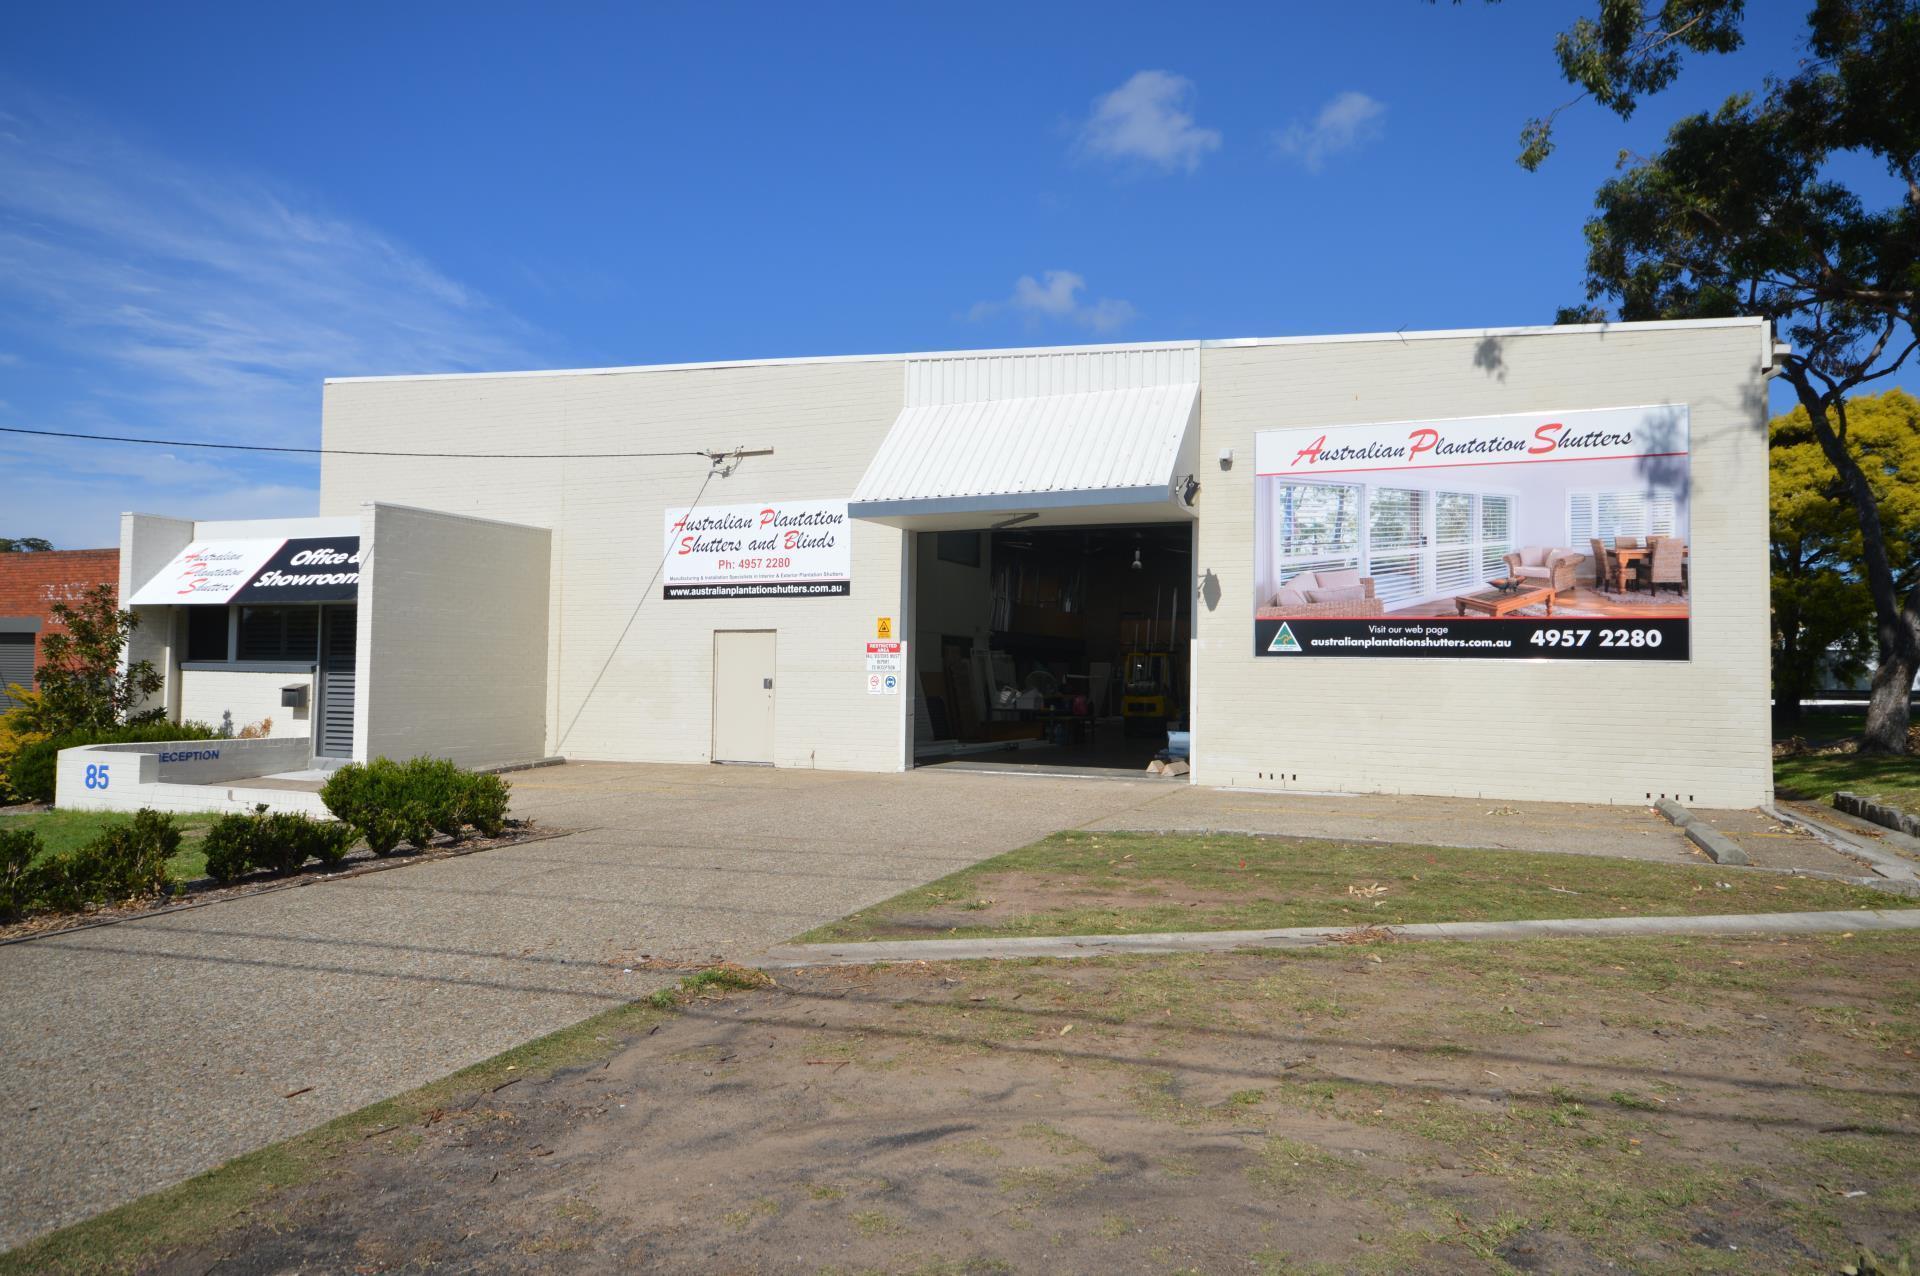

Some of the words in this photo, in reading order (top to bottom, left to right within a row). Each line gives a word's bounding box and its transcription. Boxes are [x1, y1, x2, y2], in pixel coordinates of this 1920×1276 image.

[1291, 435, 1405, 466] Australian
[1408, 428, 1526, 462] Plantation
[1527, 423, 1633, 455] Shutters
[671, 513, 752, 533] Australian
[759, 508, 843, 530] Plantation
[678, 534, 743, 555] Shutters
[748, 533, 778, 550] and
[783, 530, 835, 550] Blinds
[290, 548, 349, 566] Office
[718, 559, 735, 570] Ph:
[738, 558, 763, 569] 4957
[765, 557, 791, 569] 2280
[253, 570, 360, 587] Showroom
[670, 584, 842, 597] www.australianplantationshutters.com.au
[1368, 624, 1386, 634] Visit
[1388, 626, 1402, 634] our
[1404, 624, 1423, 634] web
[1425, 626, 1449, 636] page
[1529, 629, 1592, 648] 4957
[1599, 629, 1663, 648] 2280
[1310, 636, 1513, 649] australianplantationshutters.com.au
[85, 764, 110, 790] 85
